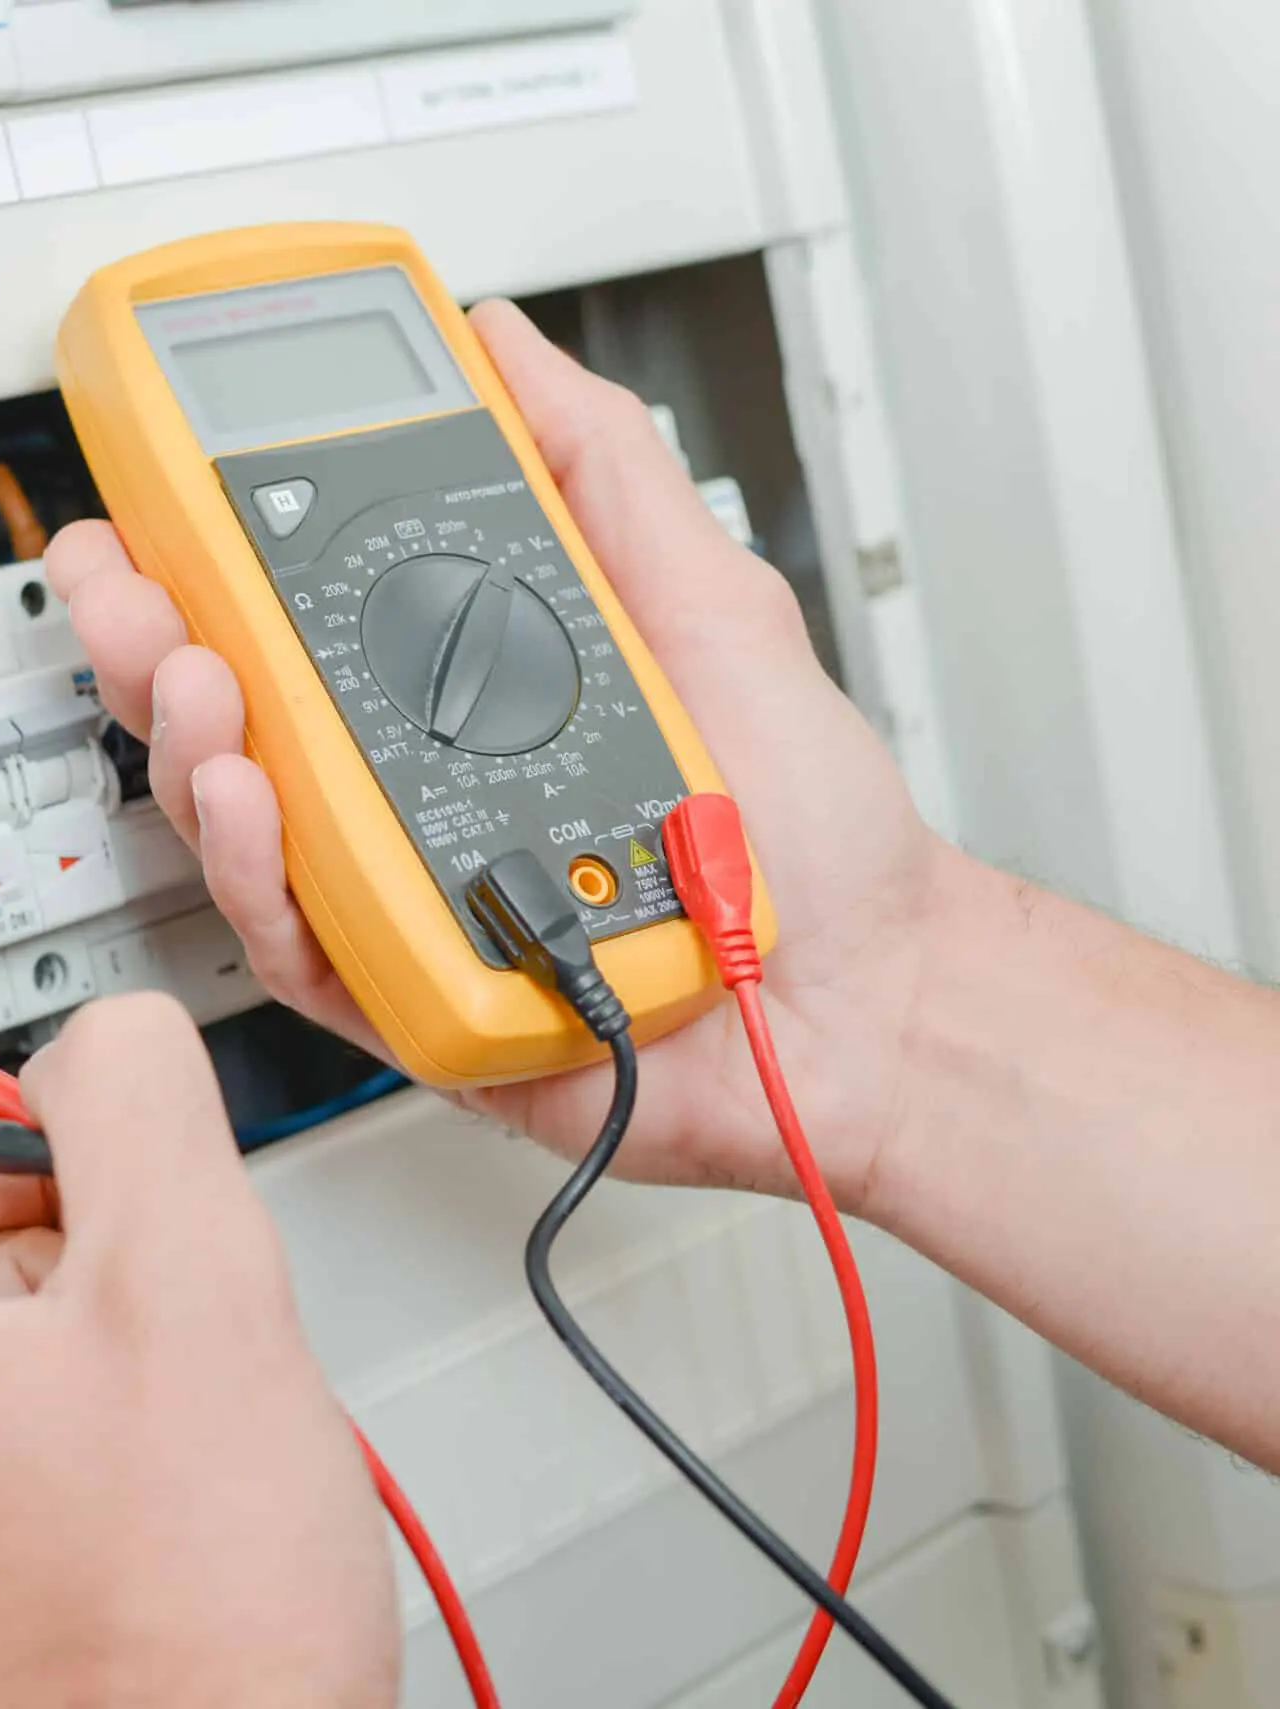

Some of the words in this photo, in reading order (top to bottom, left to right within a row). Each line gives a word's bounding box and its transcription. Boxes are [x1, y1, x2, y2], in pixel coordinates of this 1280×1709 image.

[435, 520, 467, 535] 200m
[365, 535, 392, 551] 20M
[474, 529, 484, 542] 2
[344, 554, 364, 569] 2M
[321, 582, 351, 598] 200k
[294, 592, 314, 610] Ω
[324, 613, 347, 627] 20k
[336, 676, 360, 692] 200
[361, 699, 380, 713] 9V
[594, 704, 607, 717] 2
[376, 723, 402, 739] 1.5V
[583, 732, 602, 744] 2m
[420, 750, 440, 763] 2m
[557, 751, 584, 766] 20m
[448, 761, 474, 776] 20m
[484, 768, 518, 784] 200m
[522, 762, 554, 778] 200m
[566, 762, 589, 777] 10A
[457, 774, 480, 789] 10A
[549, 819, 592, 845] COM
[451, 849, 487, 872] 10A
[634, 863, 658, 878] MAX
